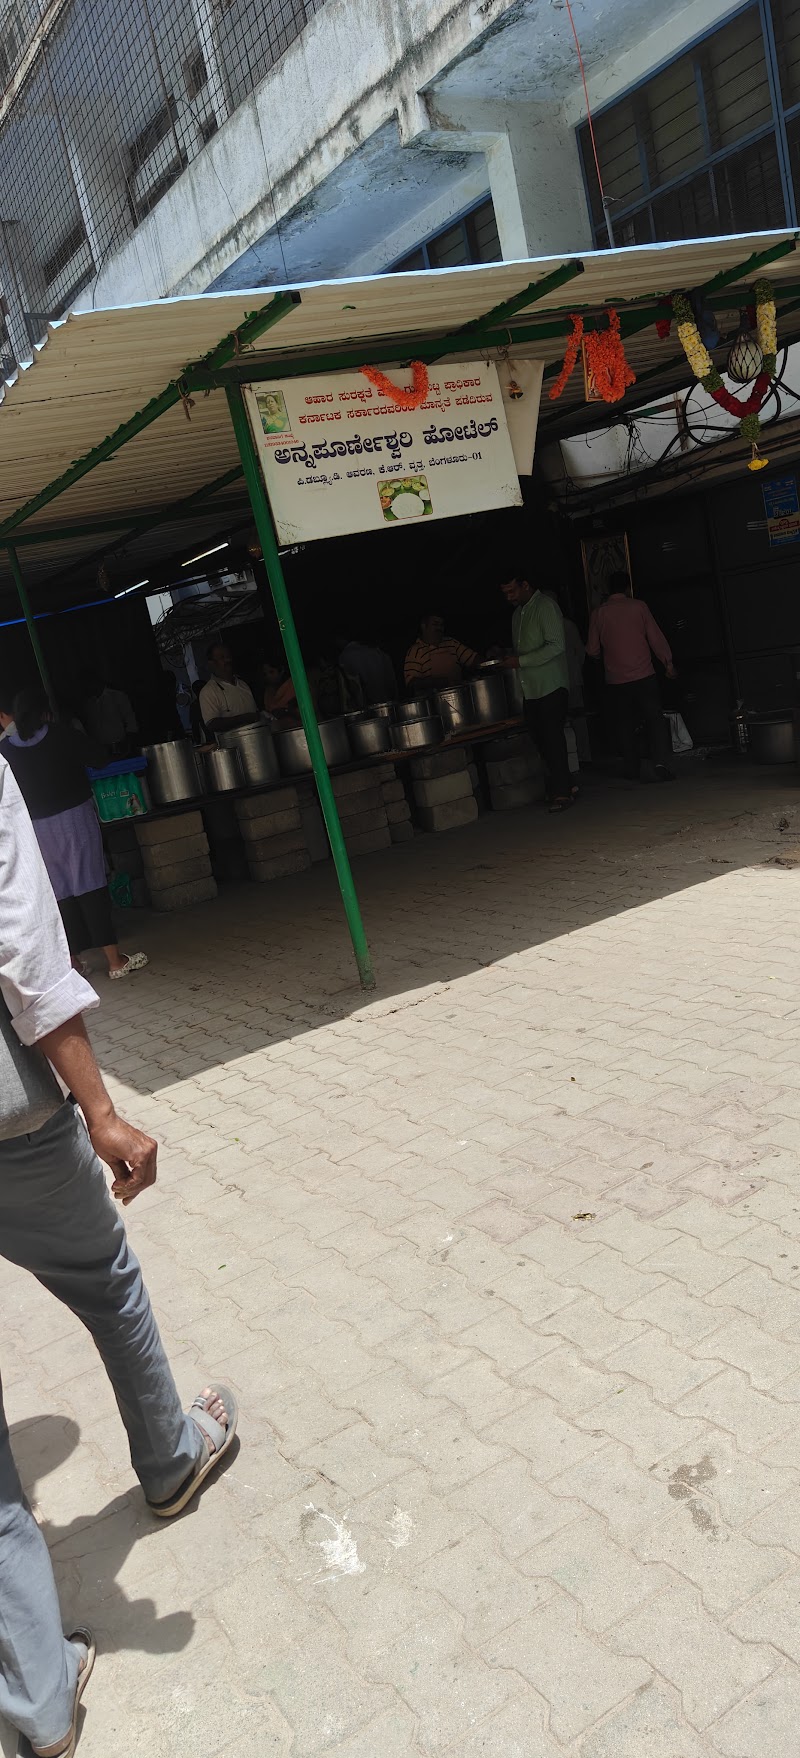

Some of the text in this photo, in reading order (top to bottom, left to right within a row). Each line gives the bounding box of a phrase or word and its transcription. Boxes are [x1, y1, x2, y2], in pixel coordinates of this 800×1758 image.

[304, 391, 334, 405] ಆಹಾರ
[338, 387, 374, 404] ಸುರಕ್ಷತೆ
[443, 377, 481, 393] ಪ್ರಾಧಿಕಾರ
[298, 392, 493, 424] ಕರ್ನಾಟಕ ಸರ್ಕಾರದವರಿಂದ ಮಾನ್ಯತೆ ಪಡೆದಿರುವ
[274, 416, 499, 469] ಅನ್ನಪೂರ್ಣೇಶ್ವರಿ ಹೋಟೆಲ್
